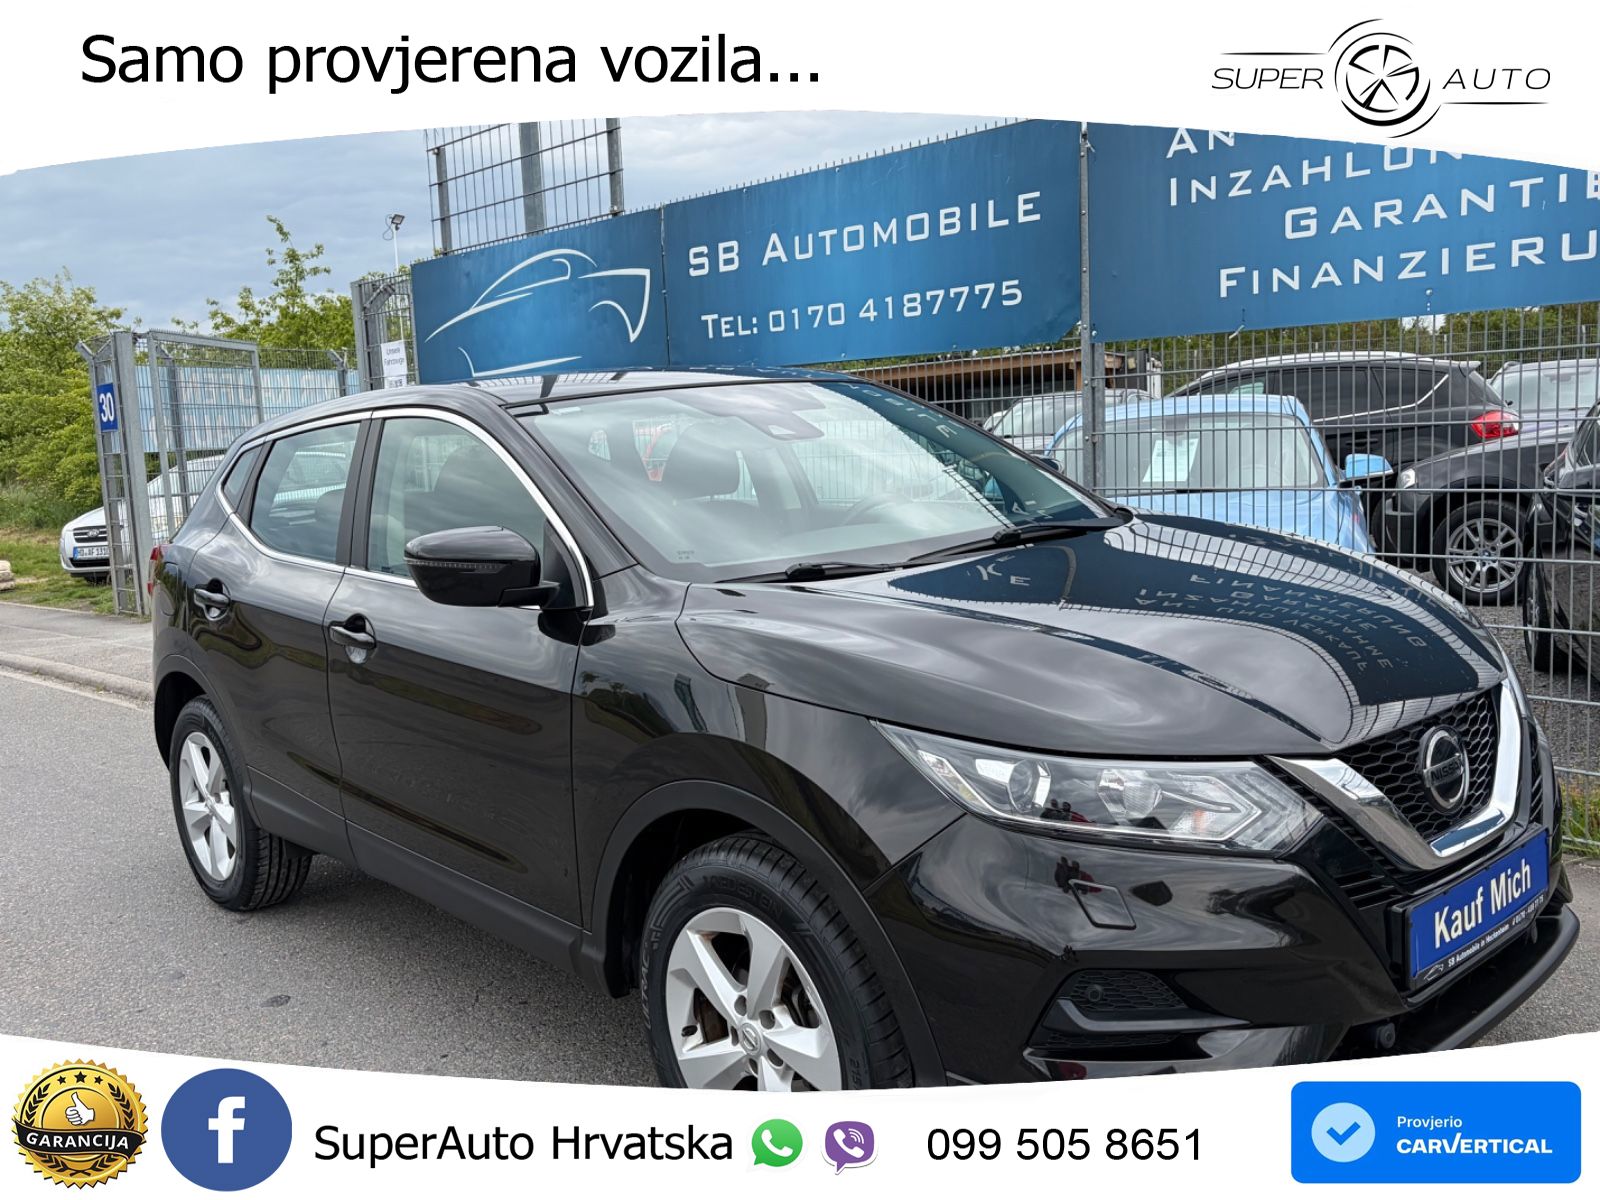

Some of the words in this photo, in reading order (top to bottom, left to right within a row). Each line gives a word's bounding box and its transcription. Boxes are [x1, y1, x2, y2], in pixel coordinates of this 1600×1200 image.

[689, 246, 738, 277] SB
[762, 191, 1041, 266] AUTOMOBILE
[1219, 230, 1597, 298] FINANZIERU
[769, 303, 845, 333] 0170
[859, 279, 1022, 322] 4187775
[99, 392, 115, 422] 30
[1434, 885, 1484, 949] Kauf
[1490, 857, 1532, 915] Mich
